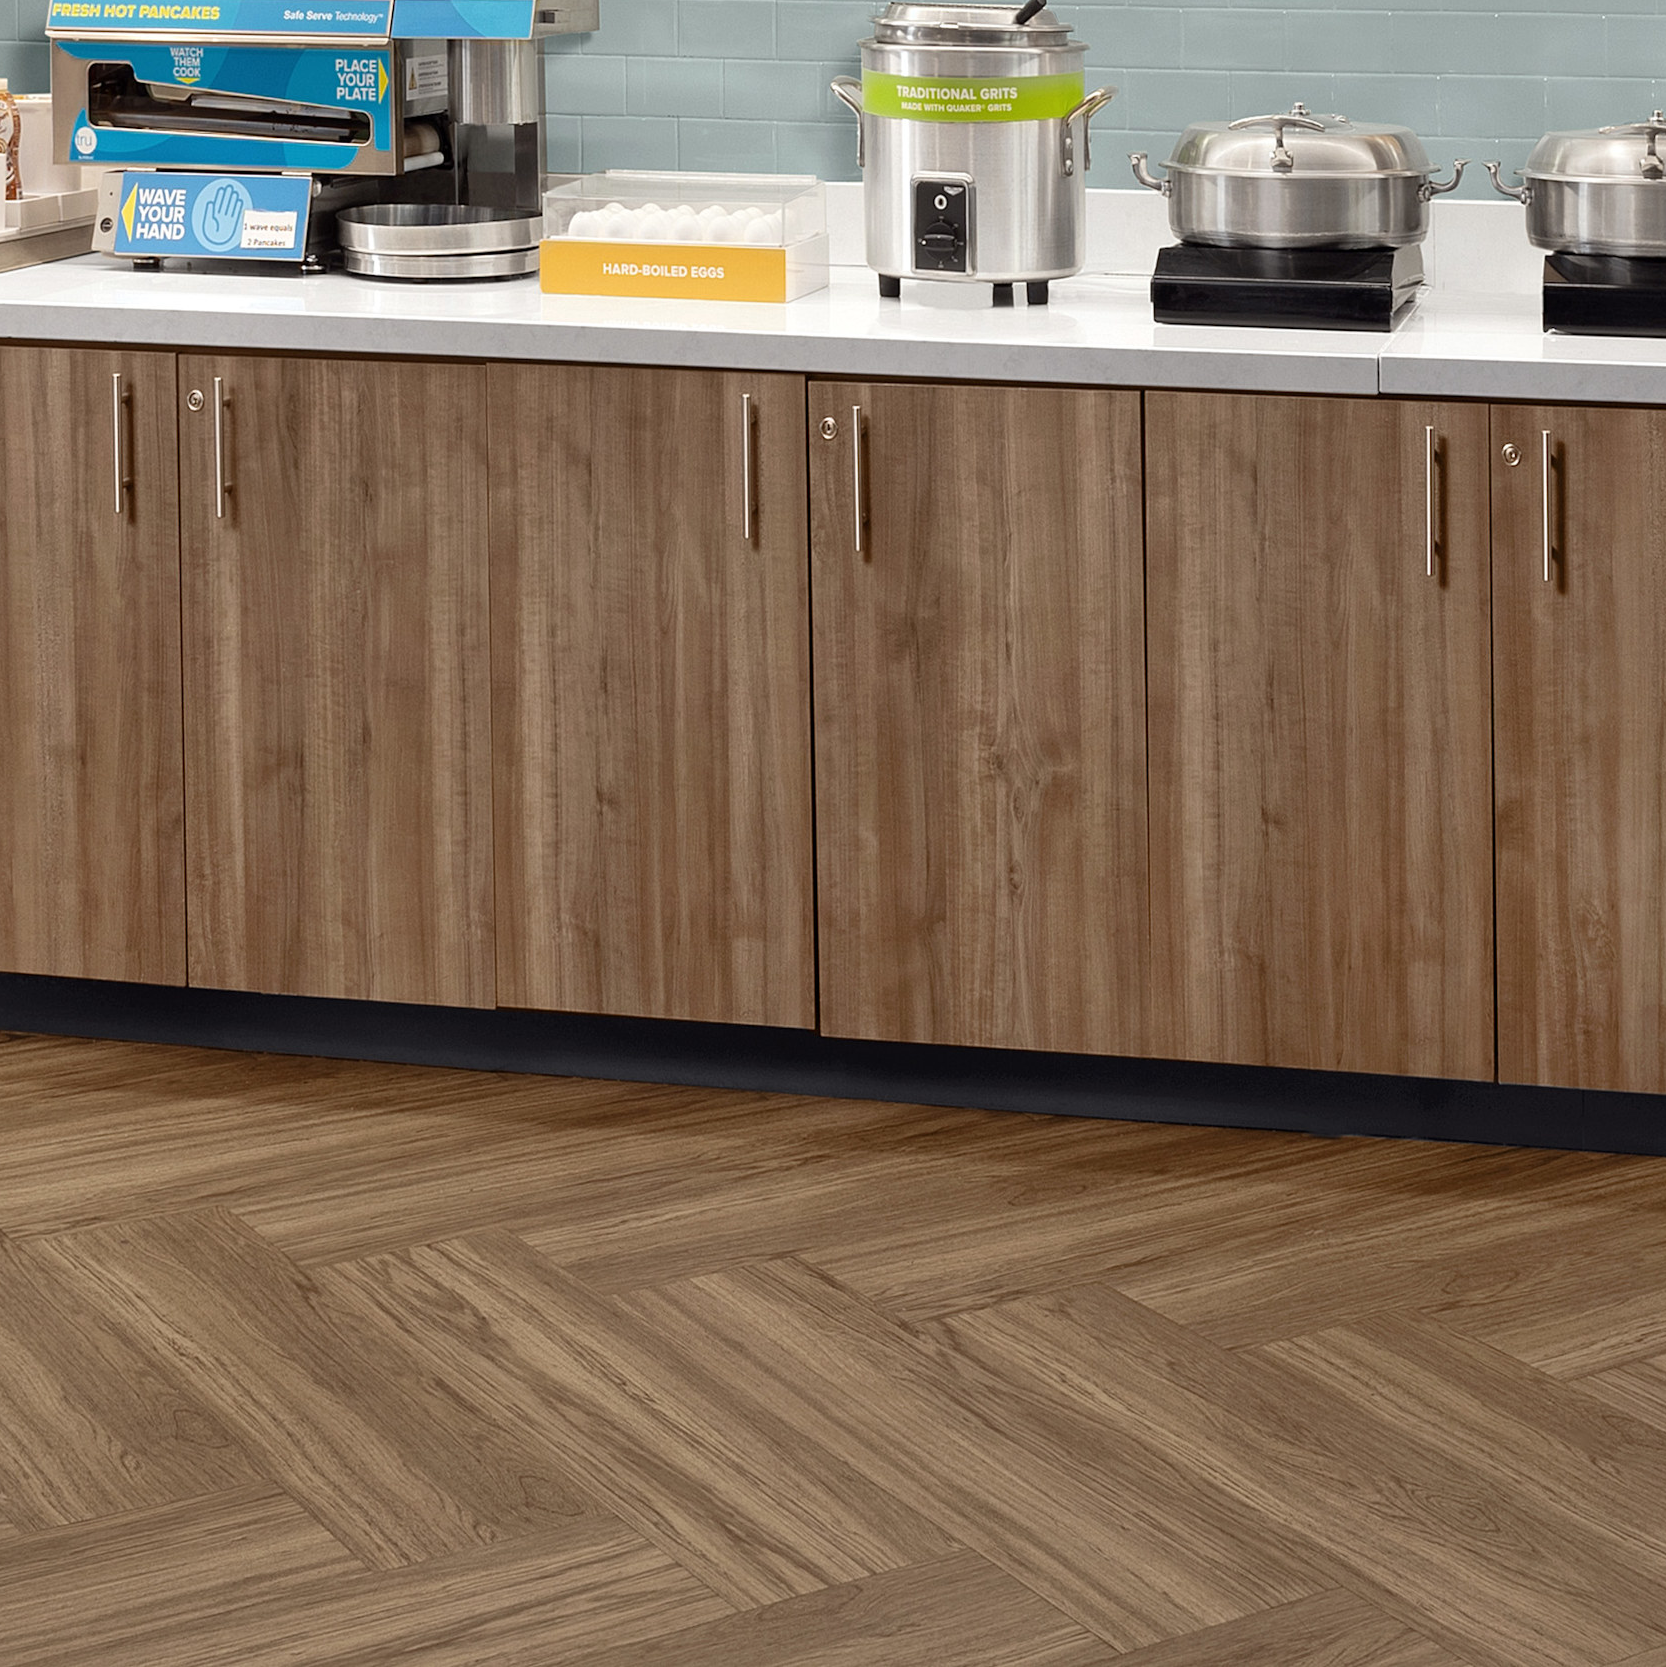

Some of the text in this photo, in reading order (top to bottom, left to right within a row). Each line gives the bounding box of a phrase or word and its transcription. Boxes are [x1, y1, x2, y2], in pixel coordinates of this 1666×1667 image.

[52, 2, 221, 20] FRESH HOT PANCAKES
[283, 10, 304, 20] Safe
[306, 10, 333, 21] Serve
[169, 47, 204, 57] WATCH
[173, 57, 200, 67] THEM
[335, 59, 377, 73] PLACE
[173, 67, 201, 77] COOK
[337, 73, 375, 87] YOUR
[336, 87, 377, 101] PLATE
[896, 85, 1018, 100] TRADITIONAL GRITS
[901, 102, 923, 111] MADE
[924, 102, 945, 112] WITH
[987, 103, 1012, 112] GRITS
[76, 134, 93, 147] tru
[138, 188, 186, 205] WAVE
[137, 206, 185, 223] YOUR
[136, 223, 185, 240] HAND
[270, 223, 292, 232] equals
[253, 238, 286, 246] Pancakes
[602, 263, 725, 279] HARD-BOILED EGGS
